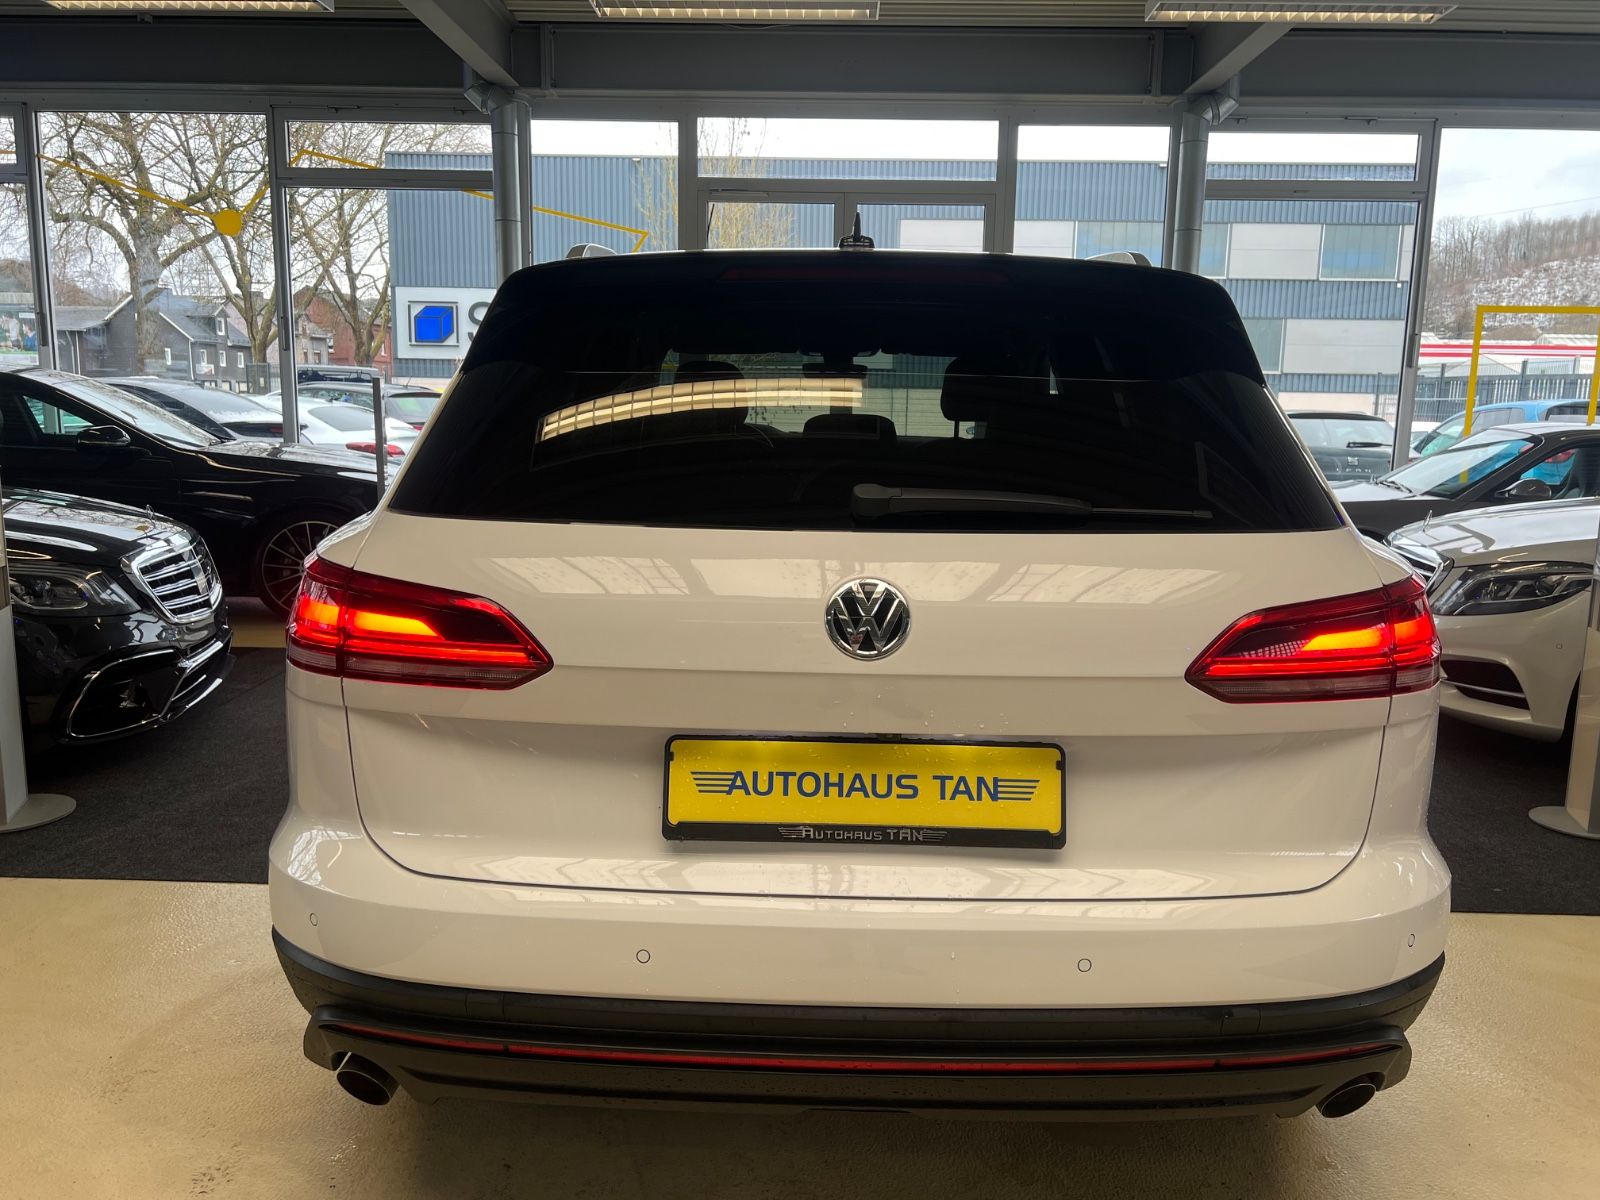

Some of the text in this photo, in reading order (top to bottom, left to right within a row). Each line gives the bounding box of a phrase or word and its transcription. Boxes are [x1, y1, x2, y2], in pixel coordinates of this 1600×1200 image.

[825, 578, 911, 661] VW
[726, 770, 999, 802] AUTOHAUS TAN
[800, 825, 924, 842] AUTOHAUS TAN
